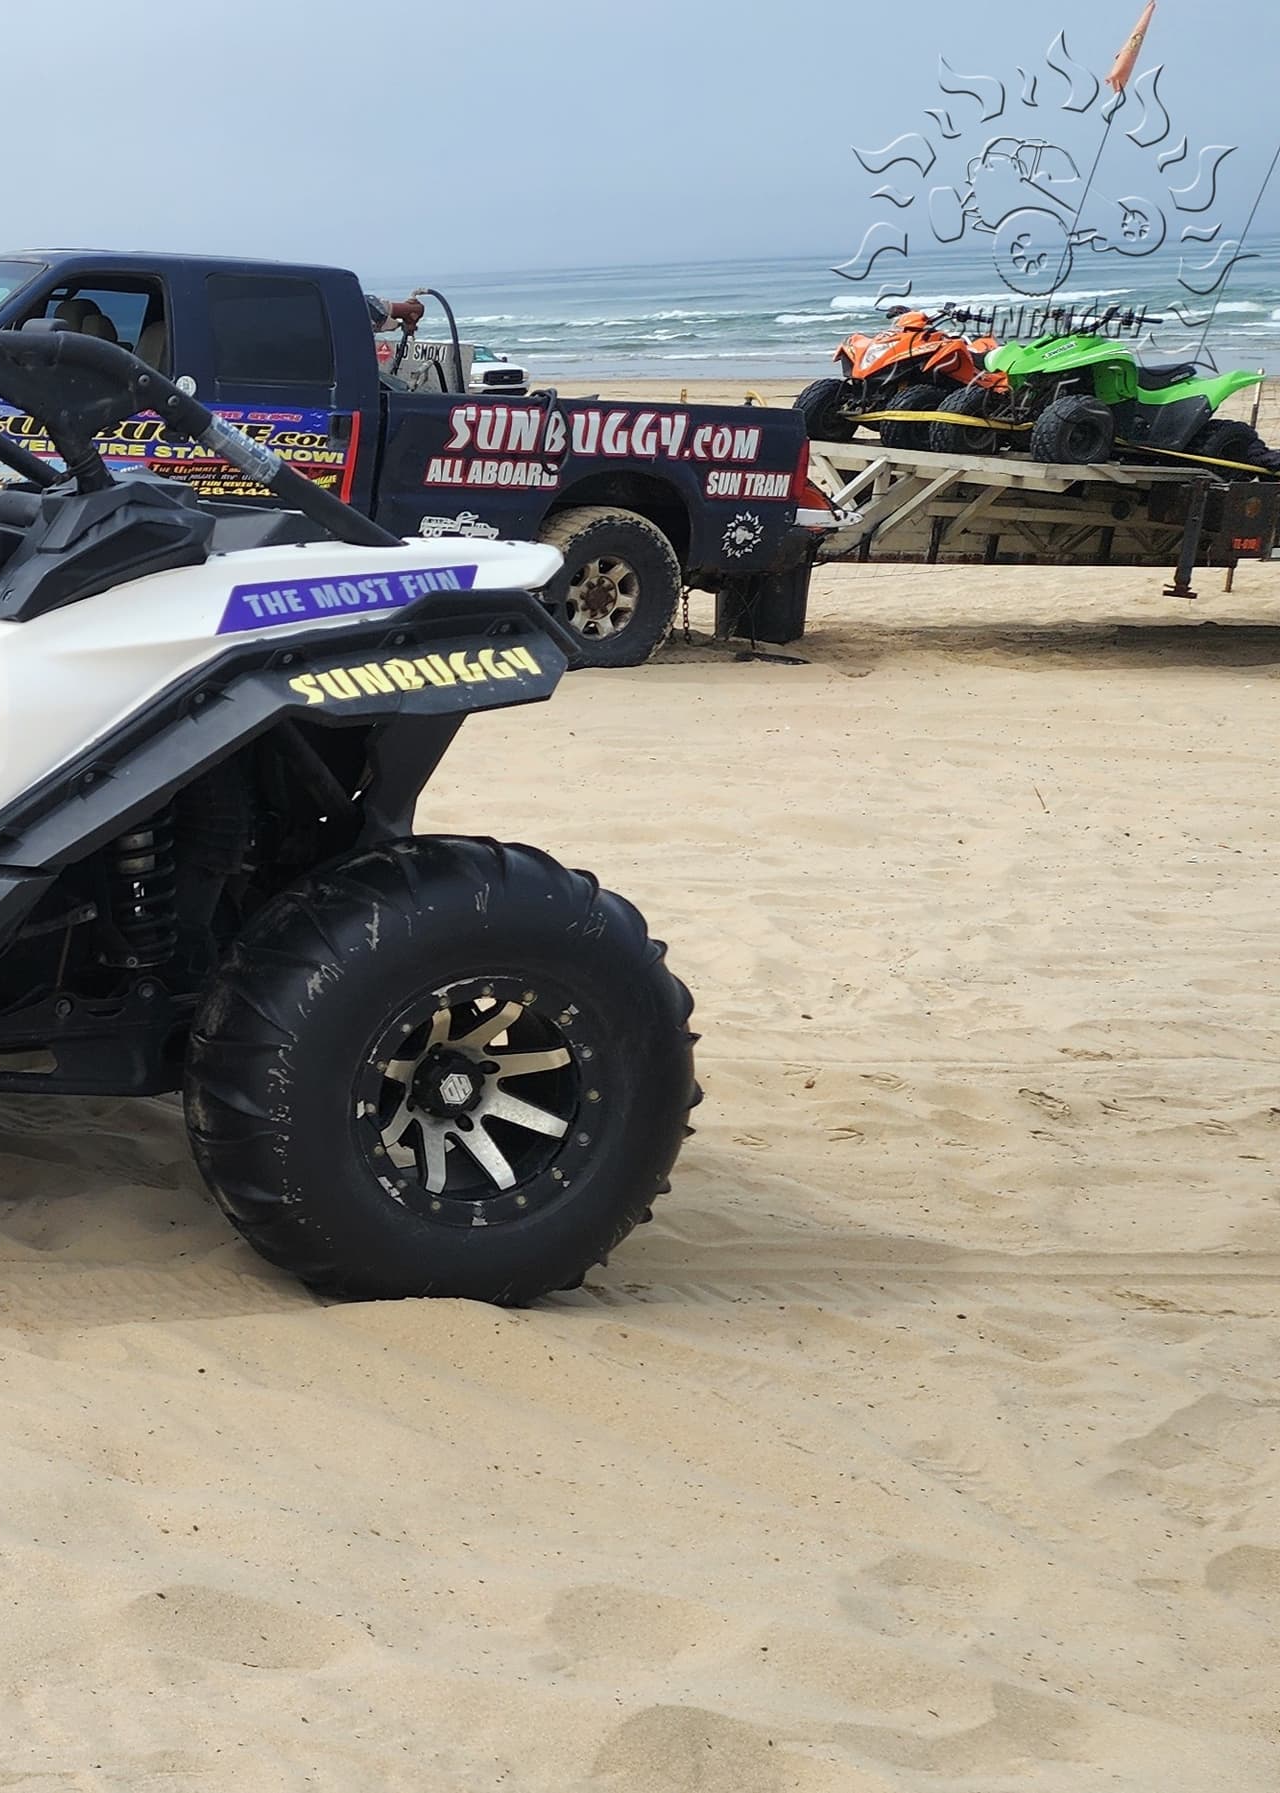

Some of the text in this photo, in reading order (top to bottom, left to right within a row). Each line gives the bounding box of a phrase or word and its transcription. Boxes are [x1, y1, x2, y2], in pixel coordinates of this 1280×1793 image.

[274, 448, 344, 464] NOW!
[426, 459, 559, 487] ALL ABOARD
[707, 470, 790, 498] SUN TRAM
[243, 570, 461, 618] THE MOST FUN
[289, 646, 542, 704] SUNBUGGY
